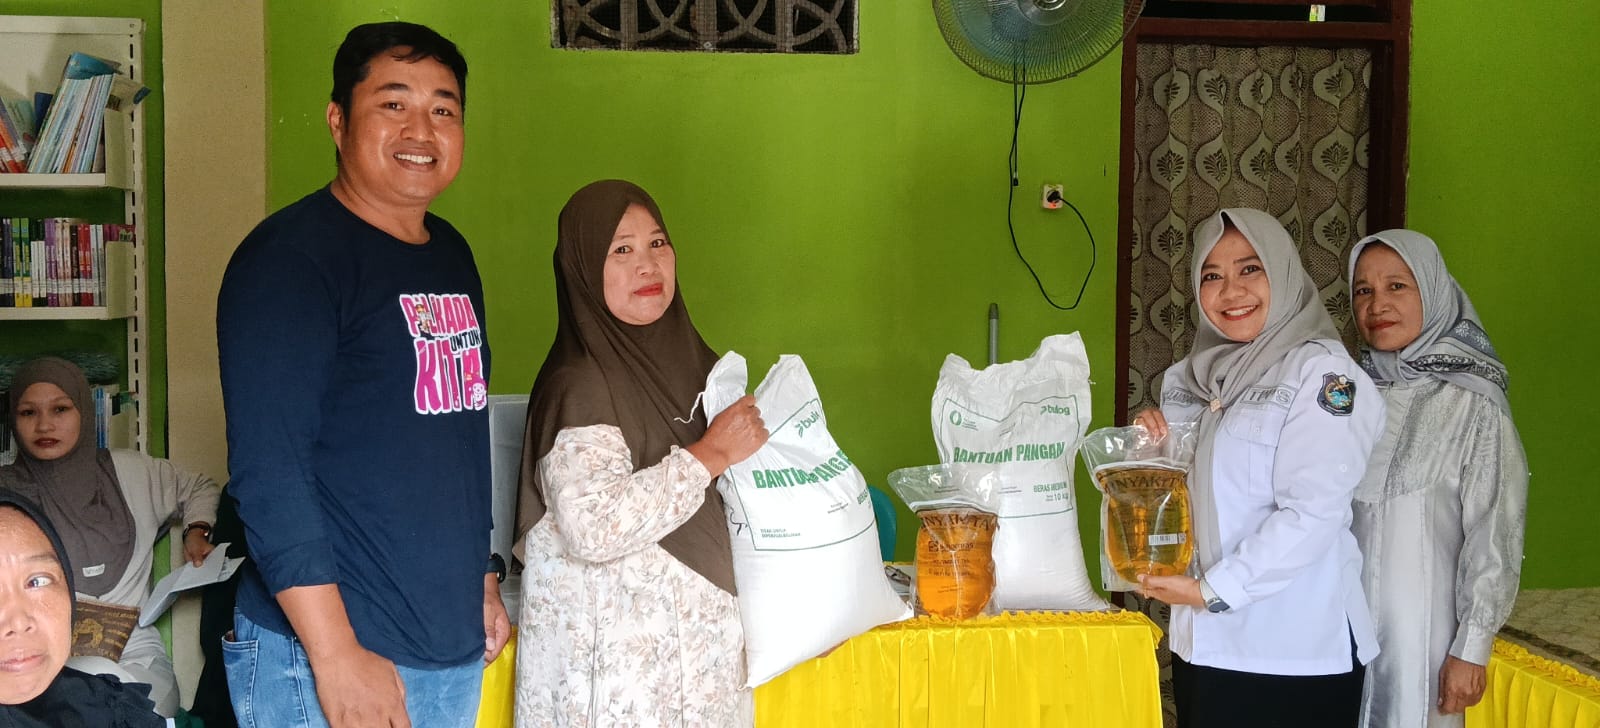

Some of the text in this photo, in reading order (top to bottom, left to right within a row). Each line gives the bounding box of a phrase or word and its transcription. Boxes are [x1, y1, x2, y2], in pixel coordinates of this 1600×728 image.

[450, 329, 481, 351] UNTUK
[1047, 404, 1070, 416] bulog
[954, 441, 1065, 464] BANTUAN PANGAN
